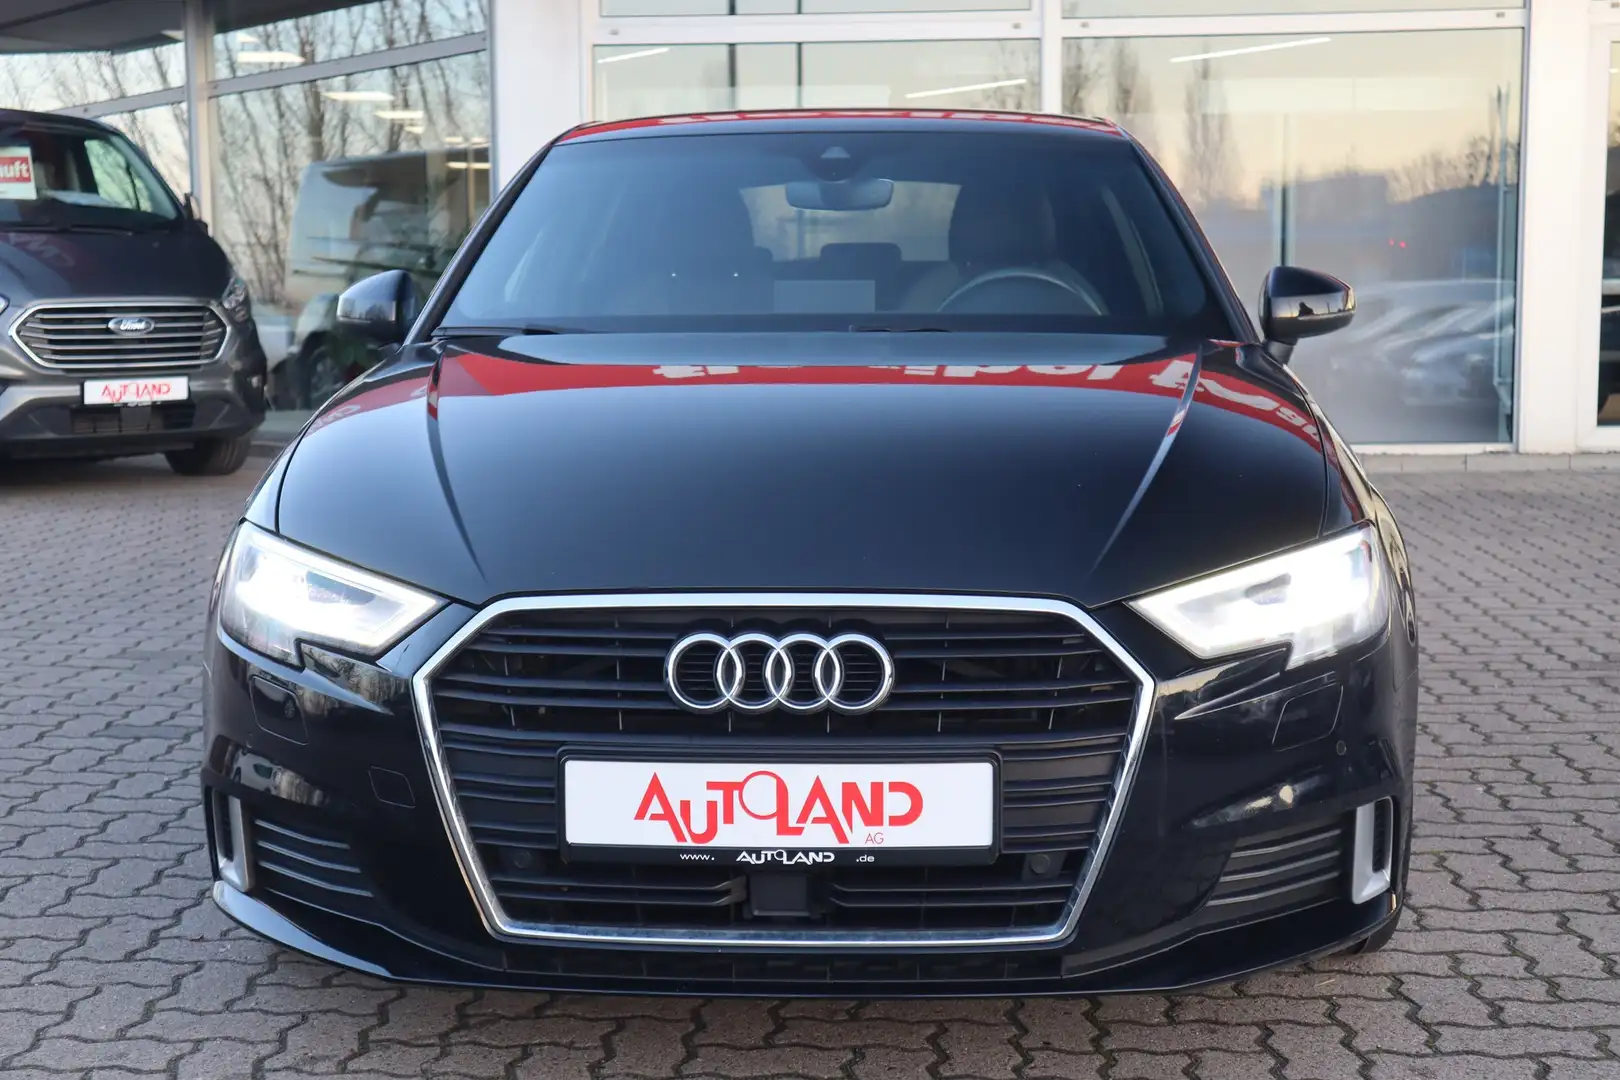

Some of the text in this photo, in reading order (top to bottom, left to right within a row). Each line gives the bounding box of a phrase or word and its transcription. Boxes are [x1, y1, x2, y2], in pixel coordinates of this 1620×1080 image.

[0, 160, 29, 178] uft
[102, 382, 172, 403] AUTOLAND
[634, 770, 924, 845] AUTOLAND
[864, 832, 885, 845] AG
[679, 849, 875, 866] www. AUTOLAND .de
